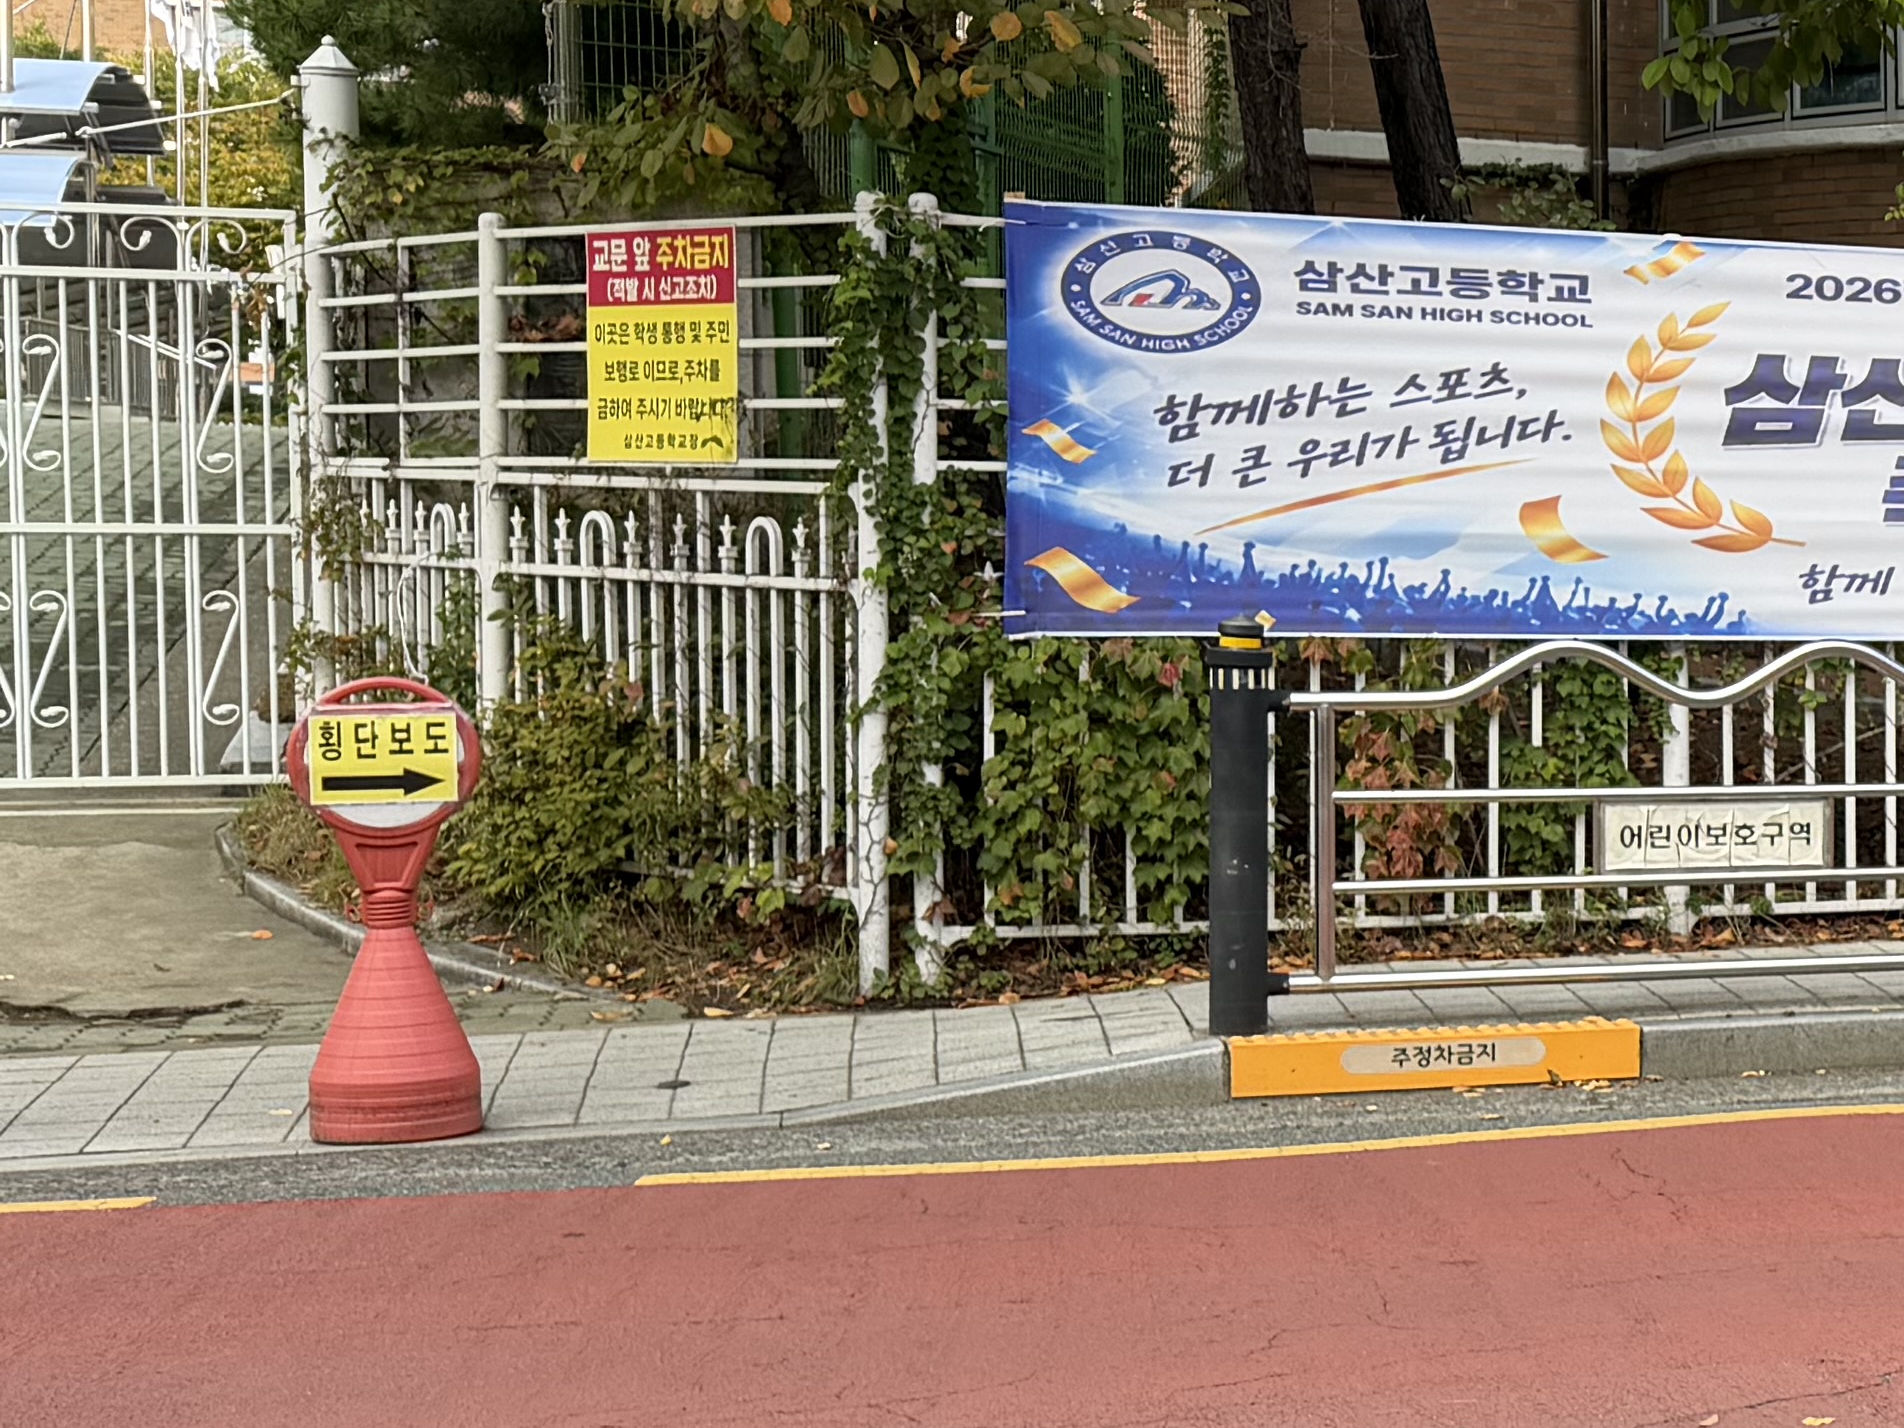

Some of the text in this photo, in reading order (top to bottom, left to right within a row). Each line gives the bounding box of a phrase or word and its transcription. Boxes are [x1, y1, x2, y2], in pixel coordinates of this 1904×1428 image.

[593, 234, 728, 272] 교문 앞 주차금지
[1075, 233, 1250, 283] 삼산고등학교
[607, 274, 717, 302] (적발 시 신고조치)
[1294, 260, 1592, 304] 삼산고등학교
[595, 320, 730, 345] 이곳은 학생 통행 및 주민
[1071, 300, 1254, 351] SAM SAN HIGH SCHOOL
[1296, 301, 1594, 328] SAM SAN HIGH SCHOOL
[604, 360, 639, 382] 보행로
[597, 398, 632, 420] 금하여
[636, 398, 671, 420] 주시기
[1153, 361, 1528, 444] 함께하는 스포츠,
[1167, 409, 1573, 489] 더 큰 우리가 됩니다.
[1799, 564, 1893, 604] 함께
[318, 720, 449, 762] 횡단보도
[1619, 822, 1812, 850] 어린이보호구역
[1390, 1042, 1497, 1069] 주정차금지
